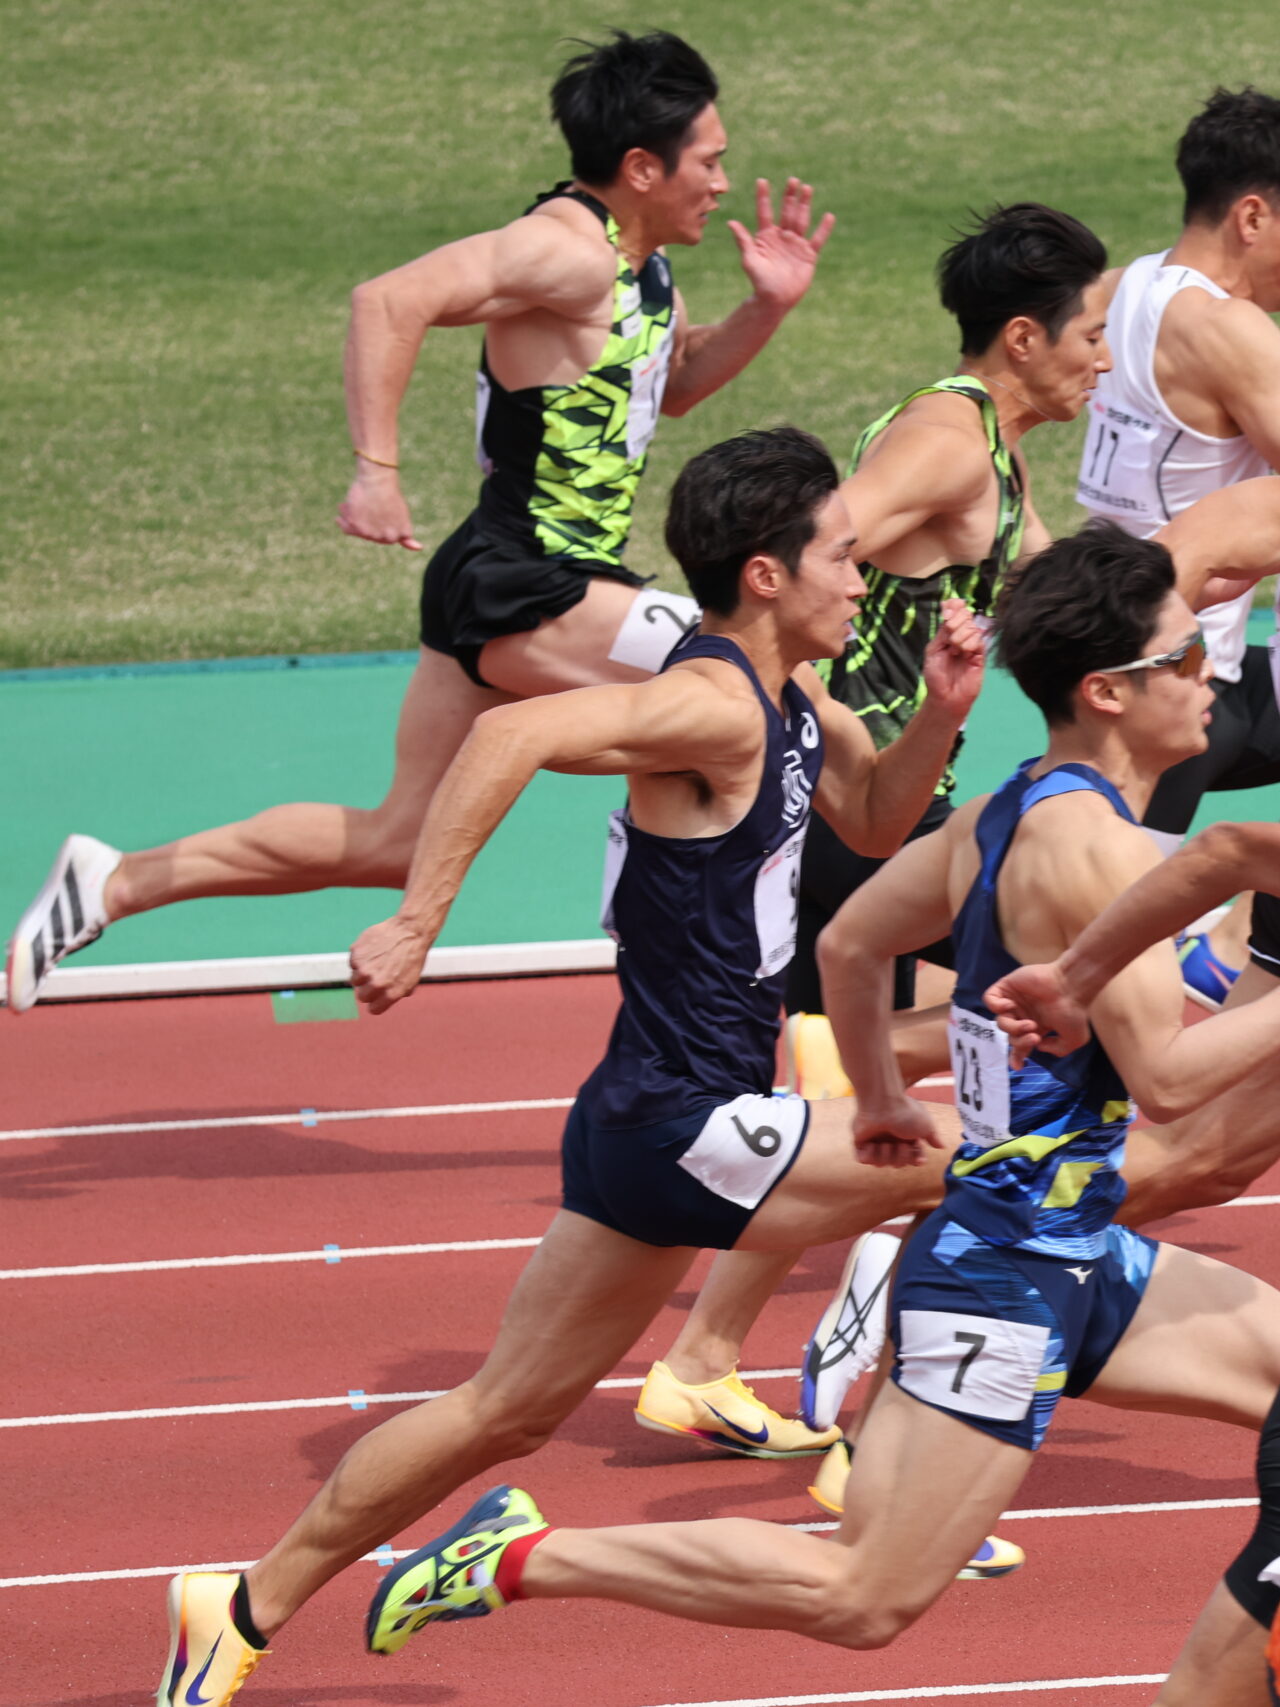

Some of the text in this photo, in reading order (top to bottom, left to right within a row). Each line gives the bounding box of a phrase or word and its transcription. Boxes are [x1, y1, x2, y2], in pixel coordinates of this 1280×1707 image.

[1088, 423, 1119, 487] 17
[643, 604, 700, 633] 2
[956, 1038, 983, 1112] 23
[730, 1114, 782, 1158] 6
[950, 1330, 987, 1394] 7
